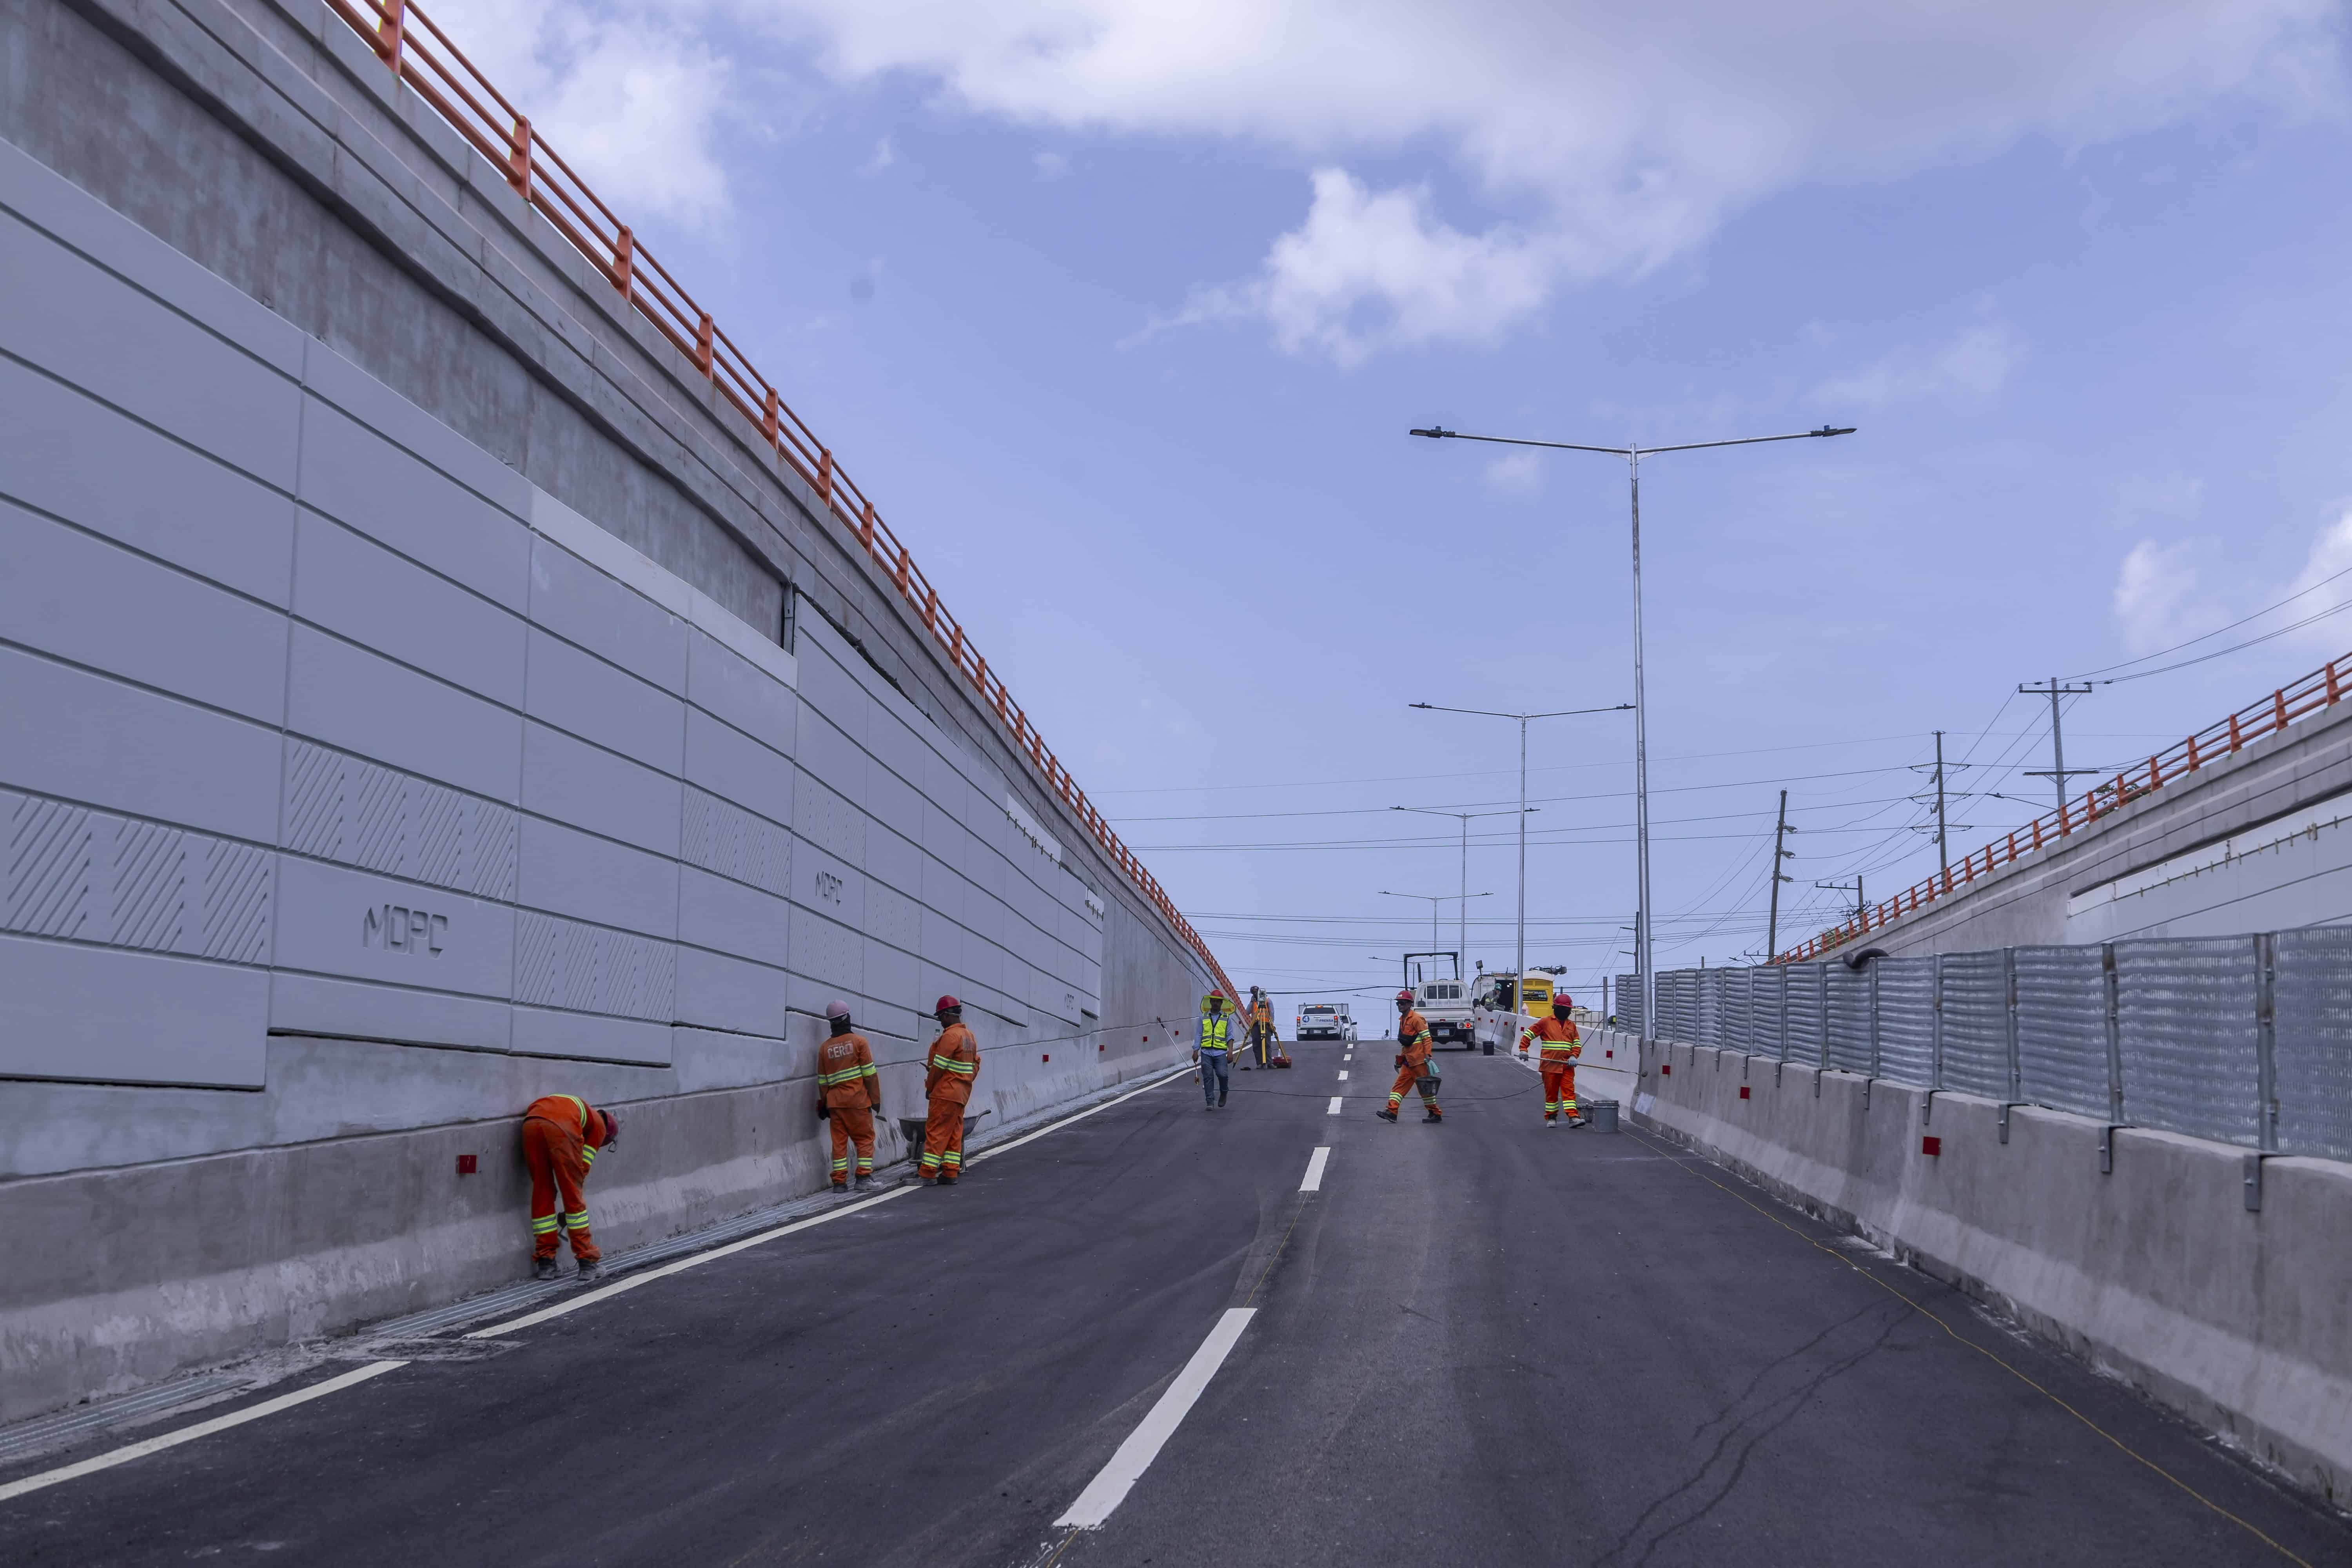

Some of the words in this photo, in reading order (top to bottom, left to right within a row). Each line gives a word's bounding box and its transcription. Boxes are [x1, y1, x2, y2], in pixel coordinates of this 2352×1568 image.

[815, 870, 842, 907] MOPC
[362, 904, 448, 960] MOPC
[828, 1043, 853, 1059] CERO
